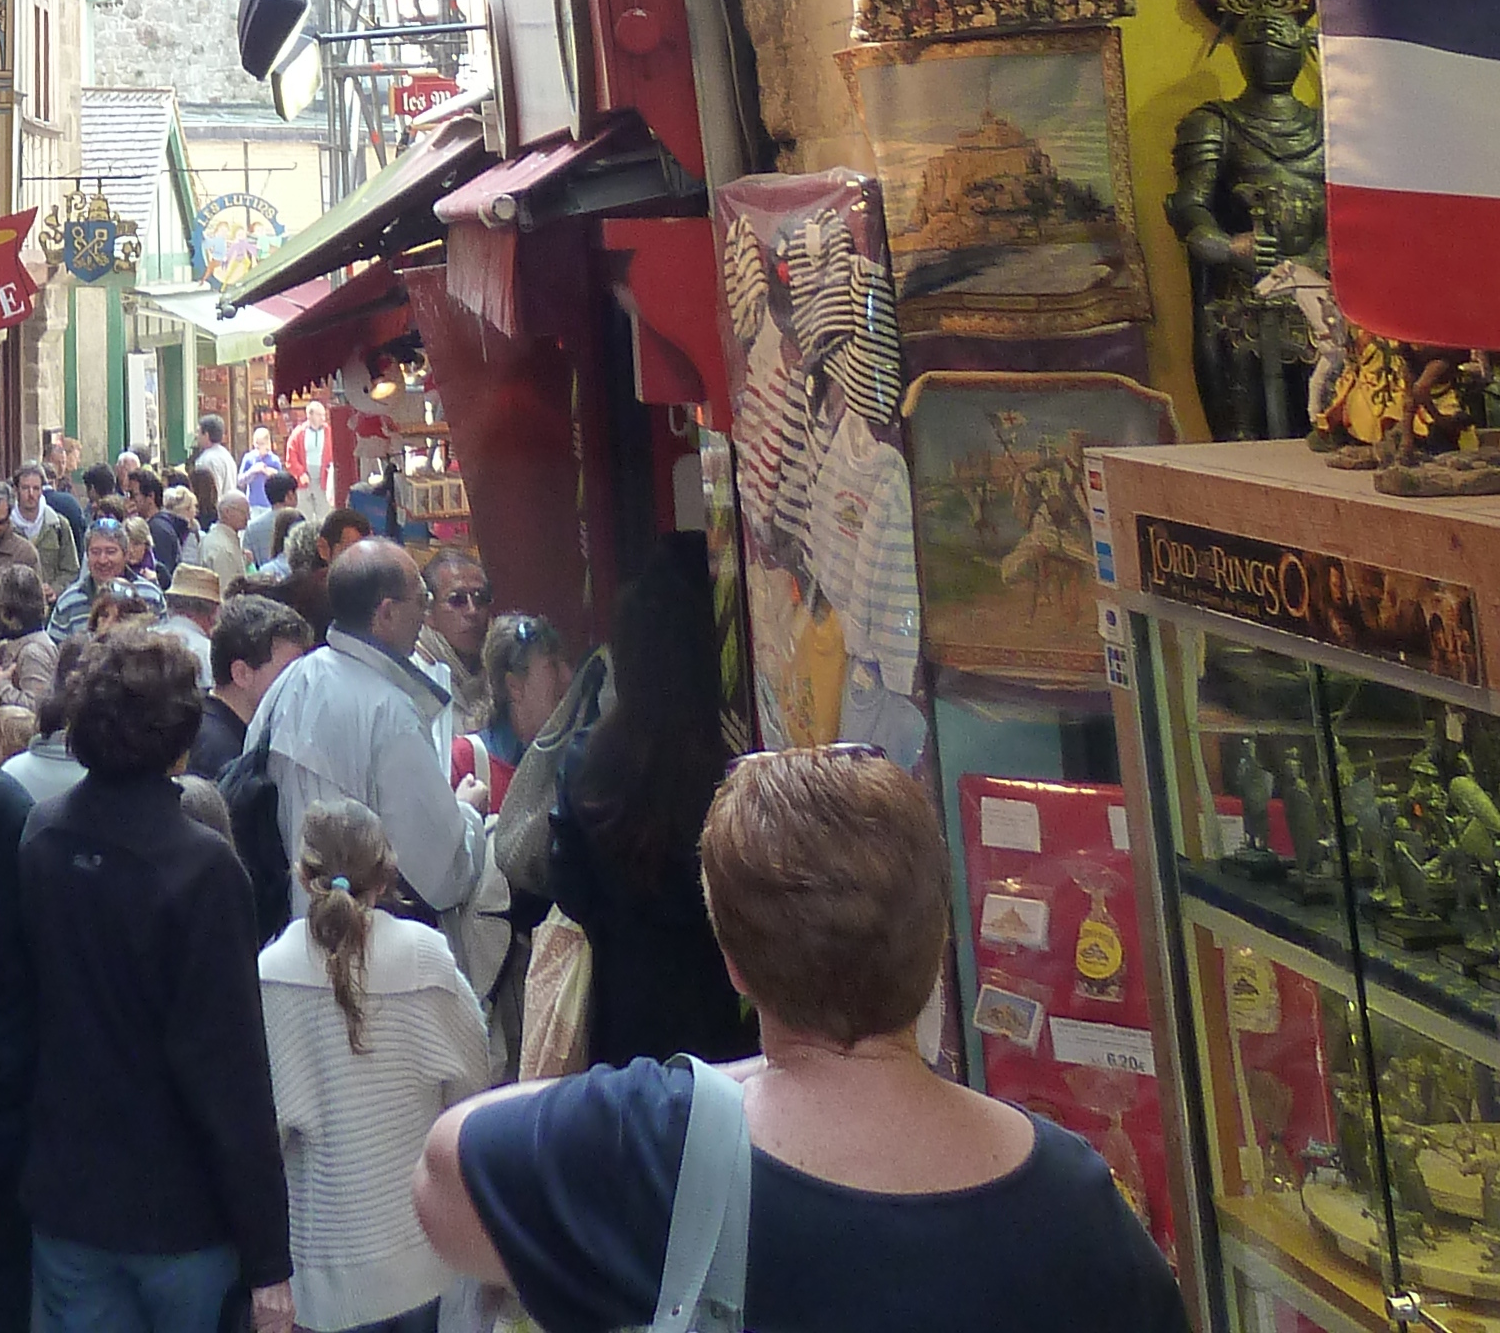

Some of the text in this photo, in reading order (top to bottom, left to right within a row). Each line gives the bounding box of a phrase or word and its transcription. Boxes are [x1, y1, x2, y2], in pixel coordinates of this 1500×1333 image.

[402, 91, 427, 112] les
[197, 202, 220, 227] LES
[1147, 526, 1198, 586] LORD
[1209, 544, 1281, 617] RINGS
